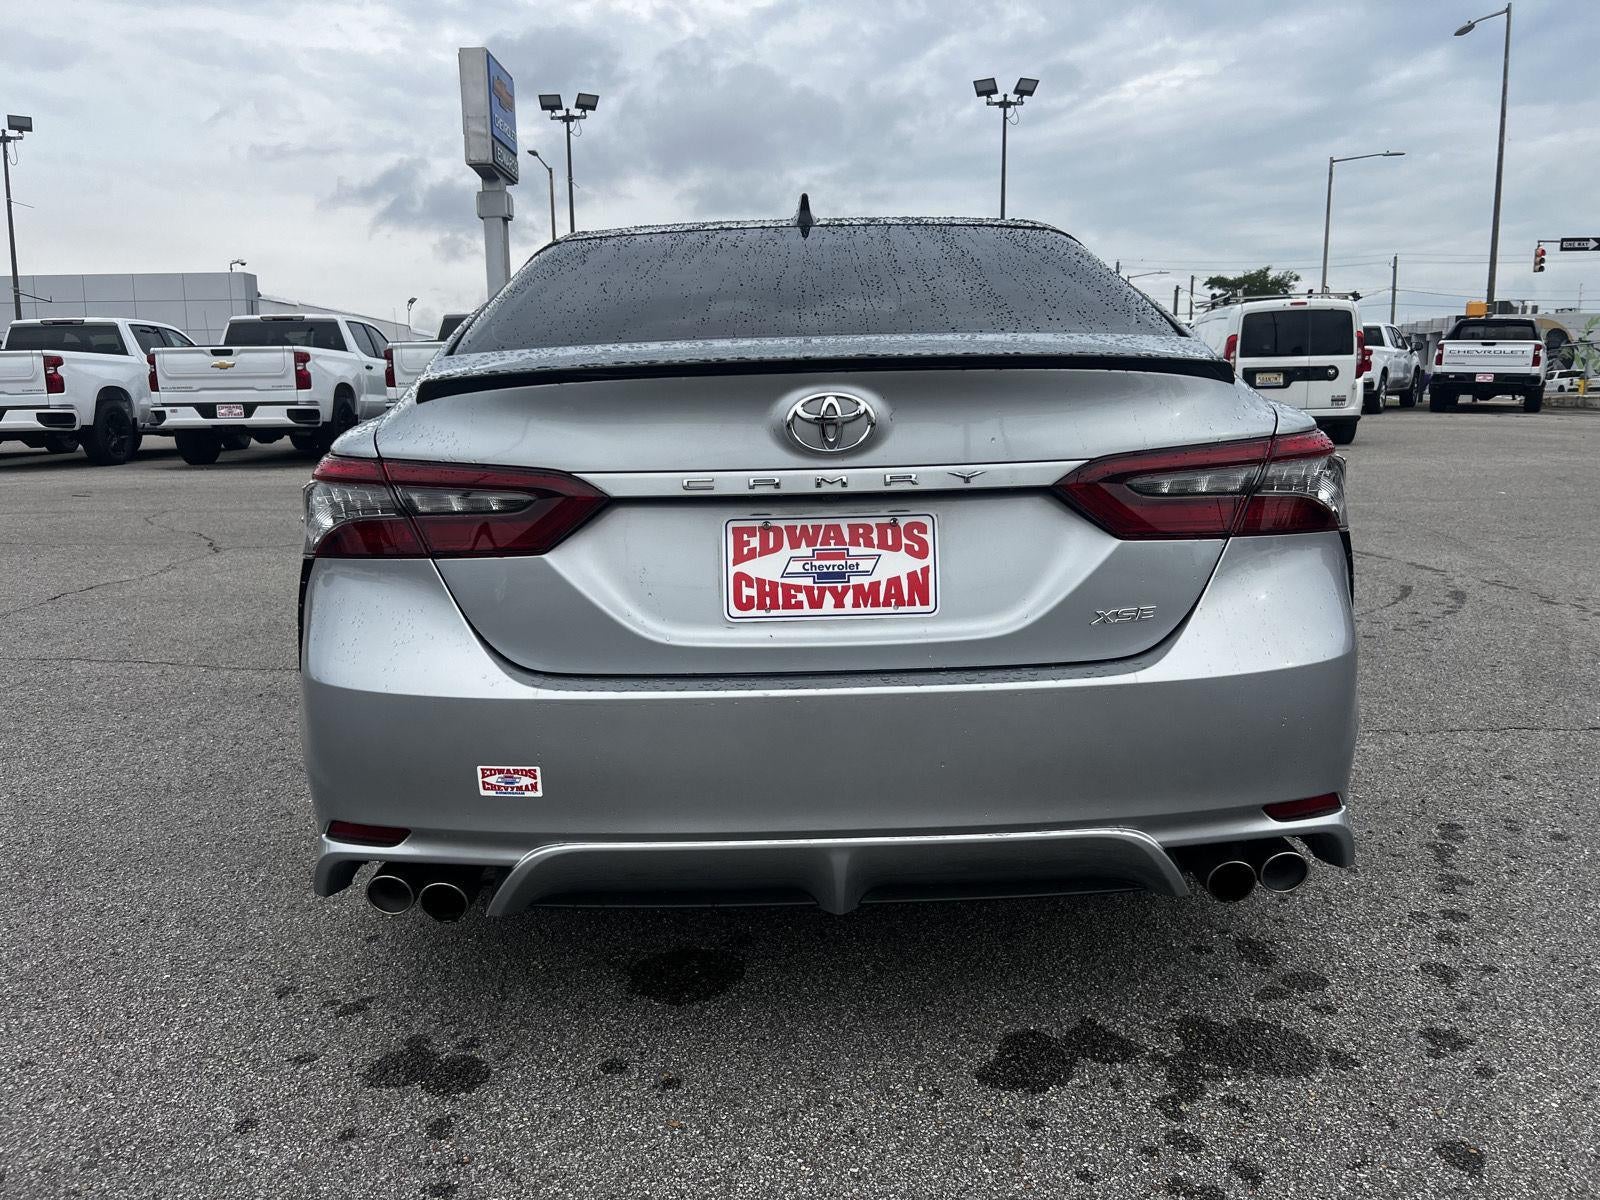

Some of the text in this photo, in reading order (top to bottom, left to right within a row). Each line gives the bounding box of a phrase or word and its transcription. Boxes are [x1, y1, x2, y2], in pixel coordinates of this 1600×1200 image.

[682, 470, 986, 491] CAMRY
[732, 521, 930, 566] EDWARDS
[802, 560, 860, 572] Chevrolet
[733, 564, 930, 612] CHEVYMAN
[1090, 605, 1157, 626] XSE
[480, 768, 538, 780] EDWARDS
[481, 780, 539, 792] CHEVYMAN
